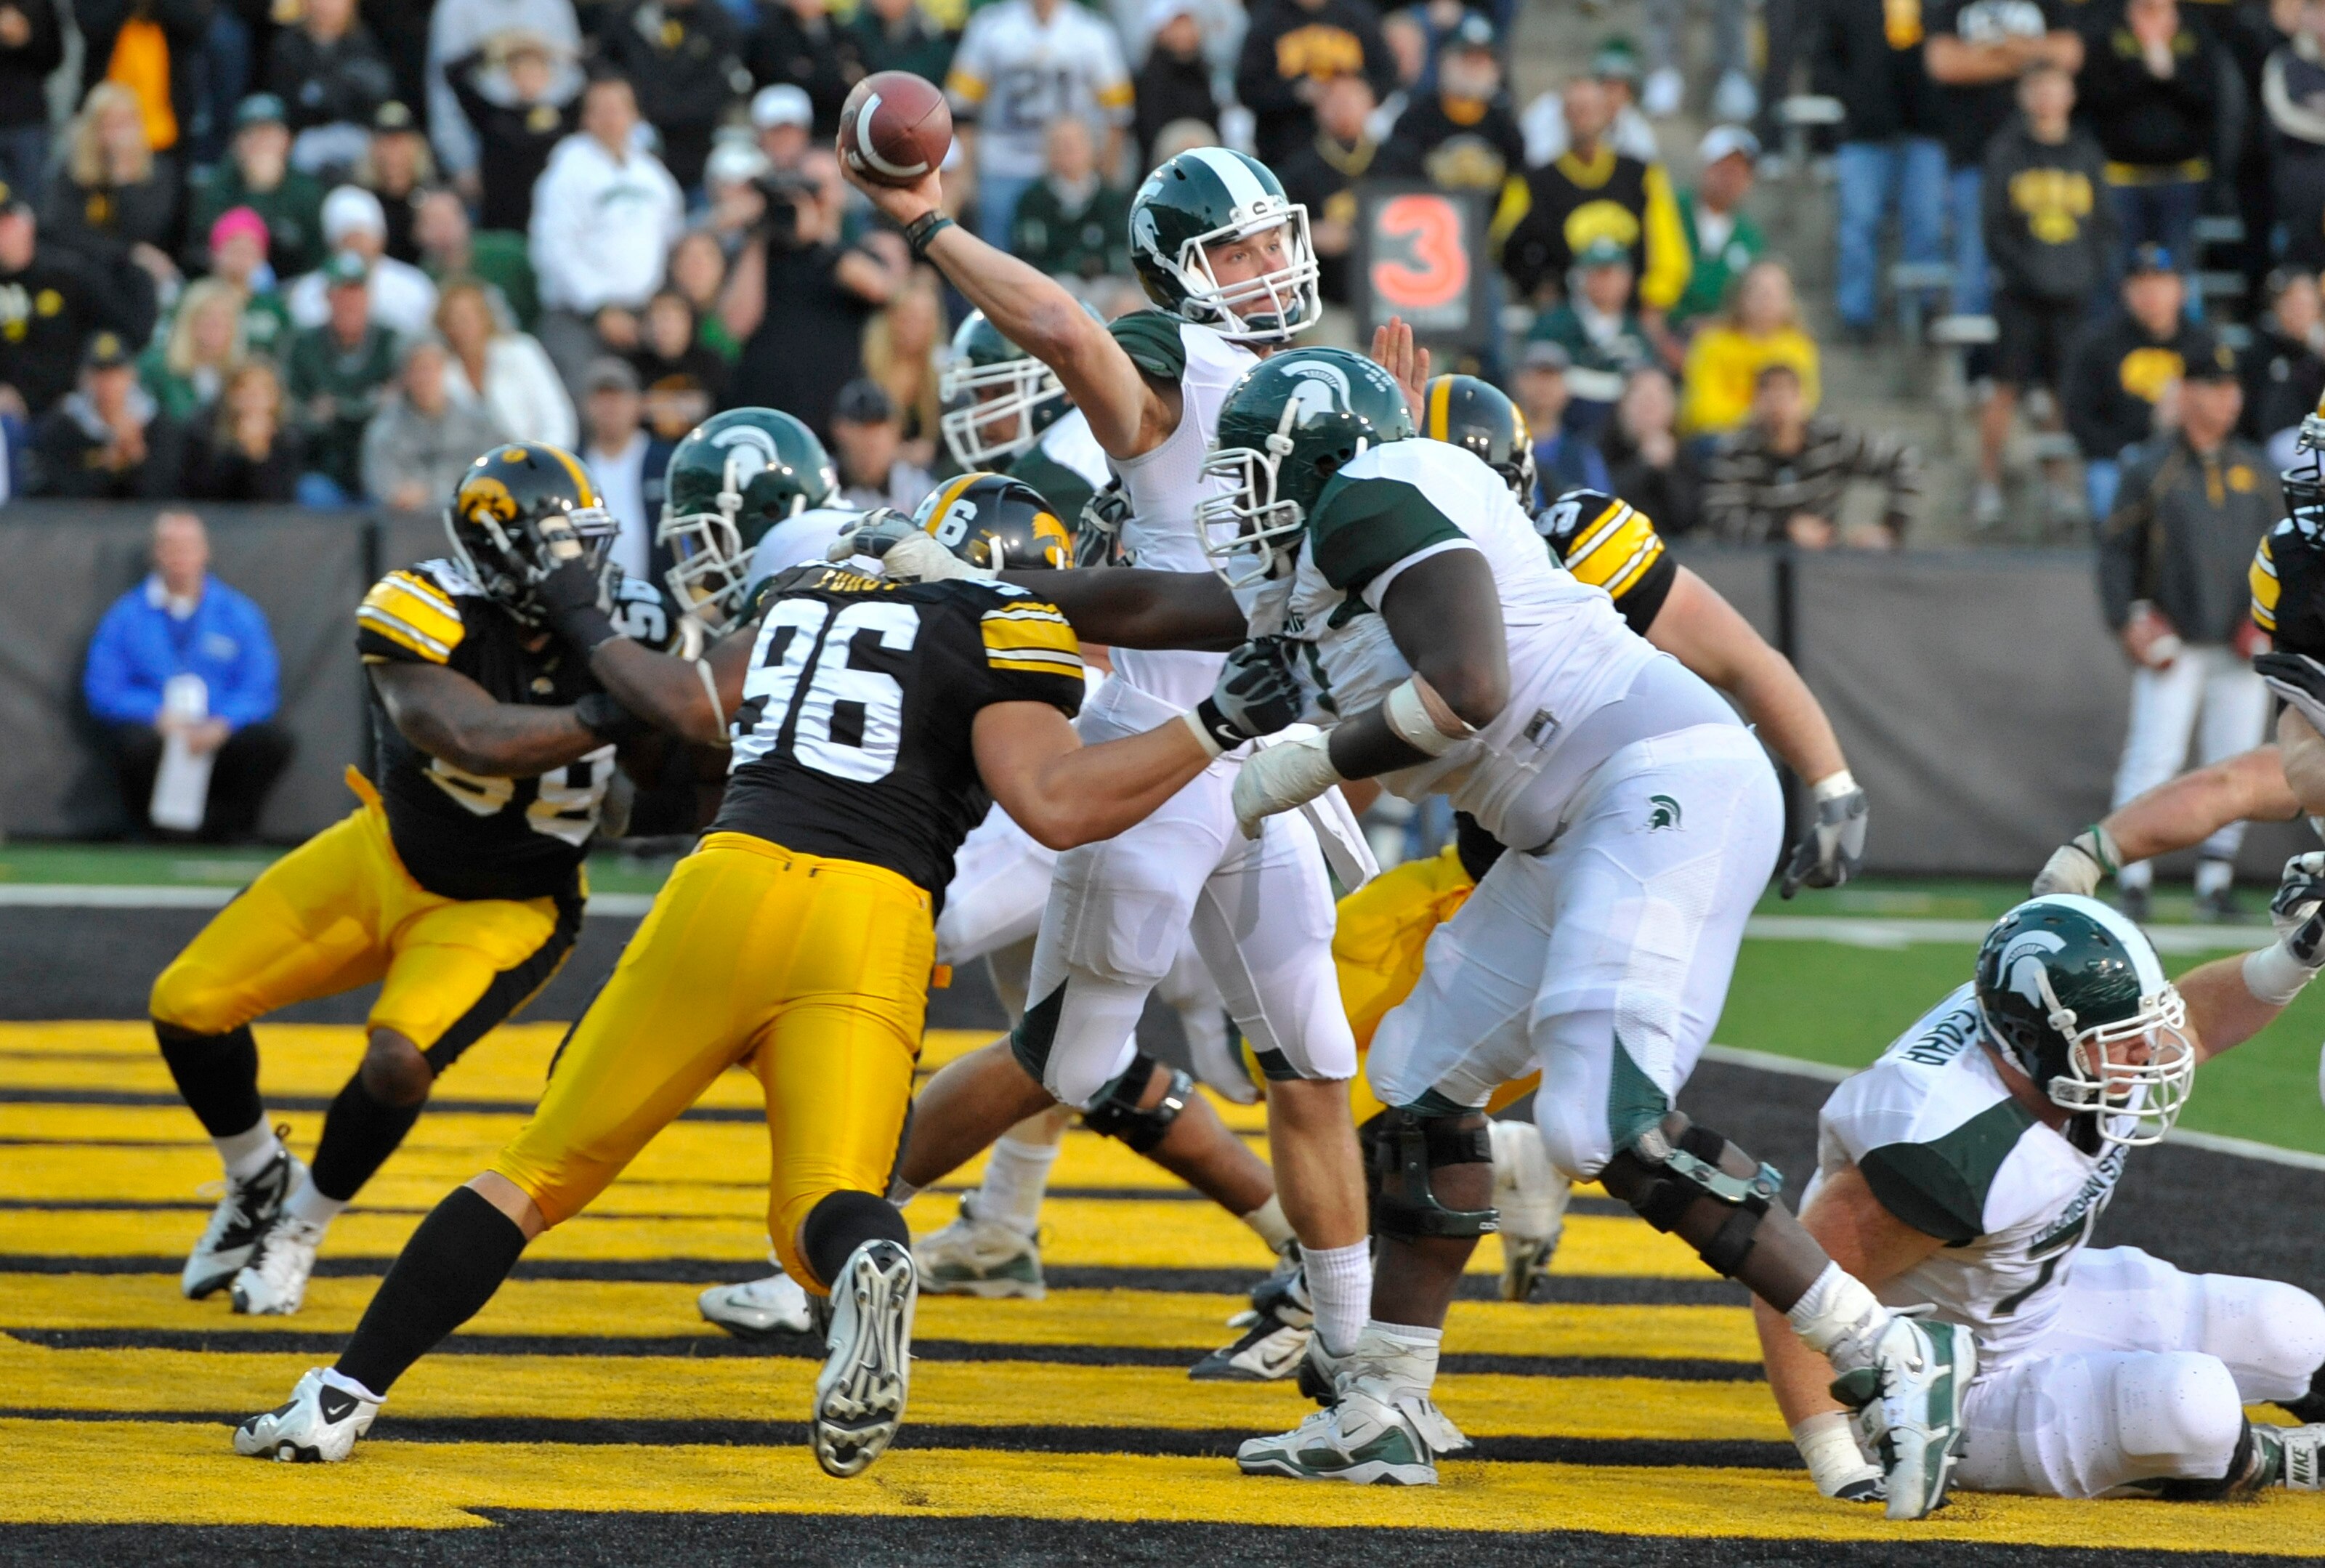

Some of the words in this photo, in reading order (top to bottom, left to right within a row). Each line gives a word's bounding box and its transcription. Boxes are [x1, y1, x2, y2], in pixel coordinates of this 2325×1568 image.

[1372, 194, 1468, 307] 3
[727, 598, 921, 783] 96
[2292, 1444, 2310, 1485] NIKE
